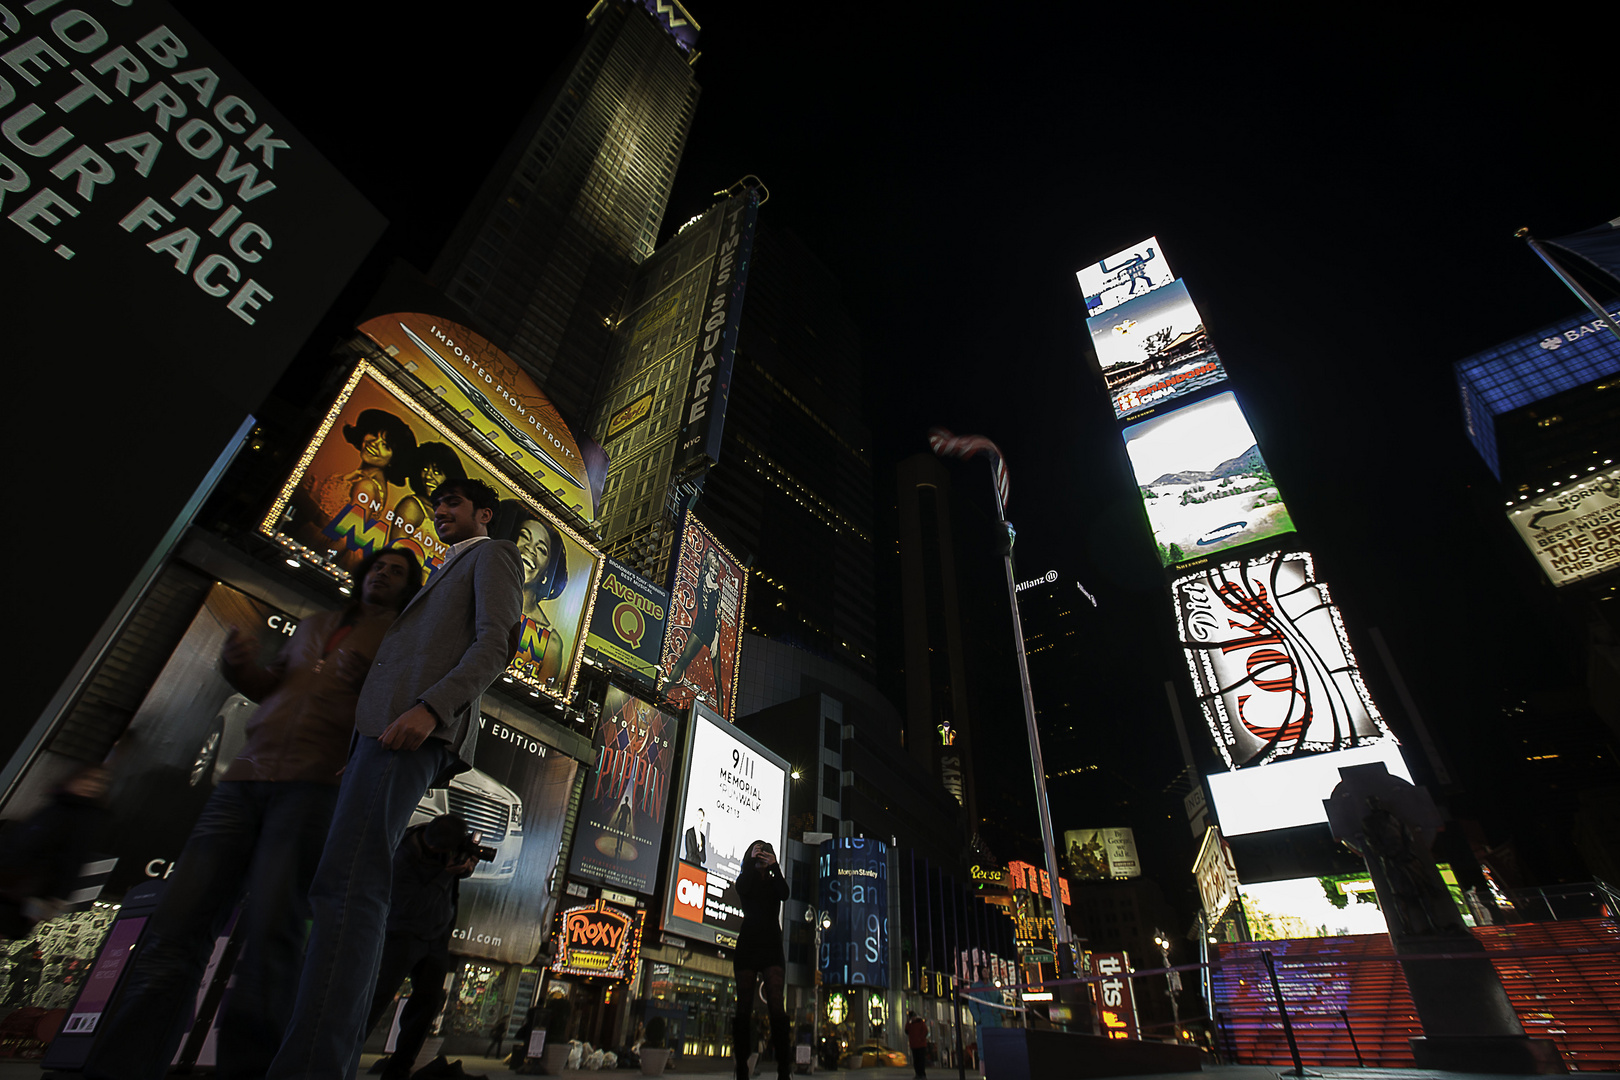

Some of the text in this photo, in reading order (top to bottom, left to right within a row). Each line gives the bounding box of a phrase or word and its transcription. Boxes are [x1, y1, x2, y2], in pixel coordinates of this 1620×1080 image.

[24, 0, 277, 202] ORROW
[136, 24, 291, 170] BACK
[104, 131, 163, 178] A
[170, 173, 273, 264] PIC
[118, 196, 274, 326] FACE
[689, 205, 744, 425] TIMES SQUARE
[430, 325, 493, 384] IMPORTED
[496, 385, 525, 416] FROM
[529, 416, 571, 457] DETROIT
[1138, 362, 1217, 396] SHANDONG
[1142, 386, 1176, 404] CHINA
[683, 435, 701, 450] NYC
[357, 492, 446, 558] ON BROADW
[1537, 528, 1573, 547] BEST
[1557, 558, 1593, 576] THIS
[602, 573, 664, 620] Avenue
[1015, 576, 1045, 593] Allianz
[612, 602, 645, 650] Q
[491, 723, 547, 758] EDITION
[611, 715, 668, 748] JOIN US
[732, 748, 755, 779] 9/11
[592, 745, 664, 824] PIPPIN
[719, 767, 762, 801] MEMORIAL
[589, 820, 601, 828] THE
[602, 825, 630, 838] BROADWAY
[838, 868, 878, 879] Morgan Stanley
[677, 878, 705, 909] CNN
[451, 926, 501, 947] cal.com
